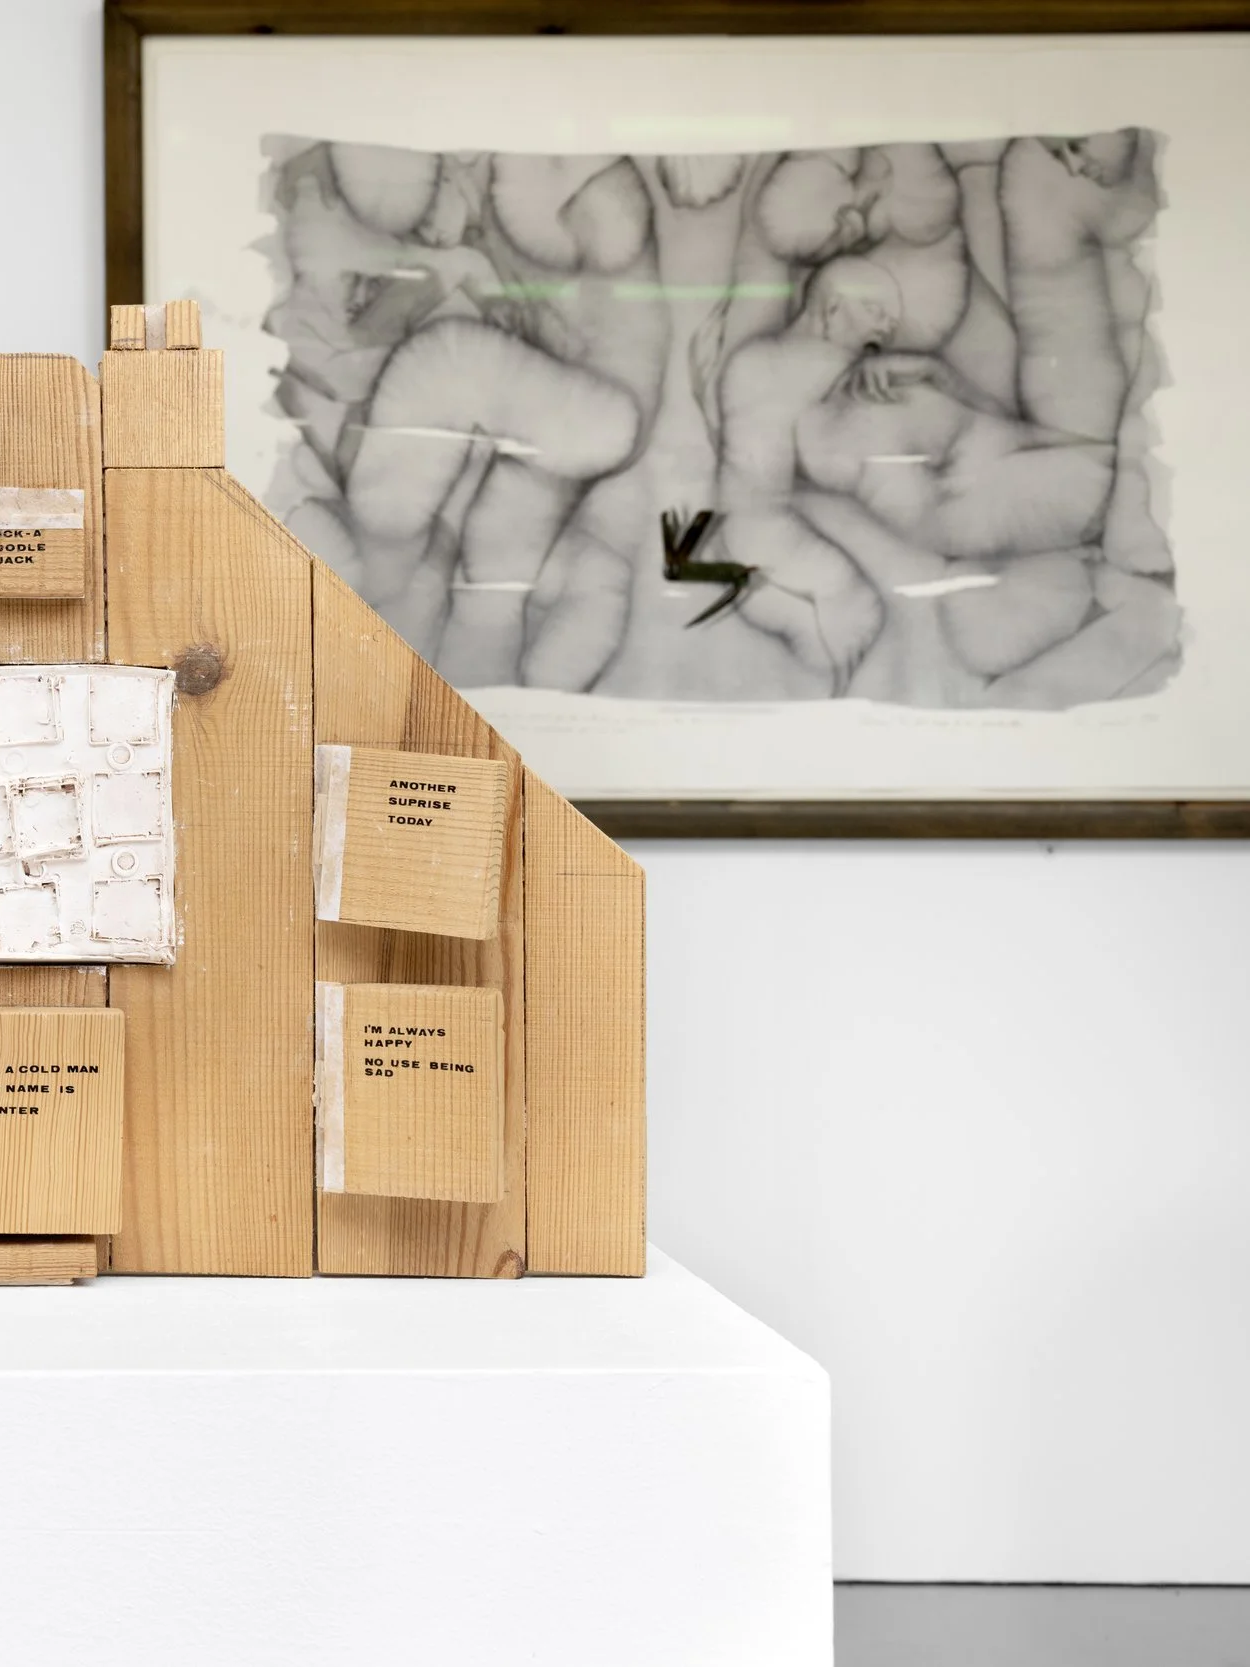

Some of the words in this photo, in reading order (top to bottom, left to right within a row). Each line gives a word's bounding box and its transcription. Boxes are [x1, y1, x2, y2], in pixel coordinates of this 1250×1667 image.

[389, 780, 457, 794] ANOTHER
[388, 796, 452, 810] SUPRISE
[387, 815, 433, 827] TODAY
[364, 1024, 382, 1034] I'M
[388, 1026, 446, 1037] ALWAYS
[364, 1039, 413, 1049] HAPPY
[5, 1065, 14, 1074] A
[18, 1064, 61, 1074] COLD
[67, 1064, 99, 1074] MAN
[364, 1057, 384, 1067] NO
[390, 1059, 420, 1069] USE
[429, 1061, 475, 1074] BEING
[364, 1067, 394, 1078] SAD
[5, 1084, 50, 1093] NAME
[59, 1085, 75, 1094] IS
